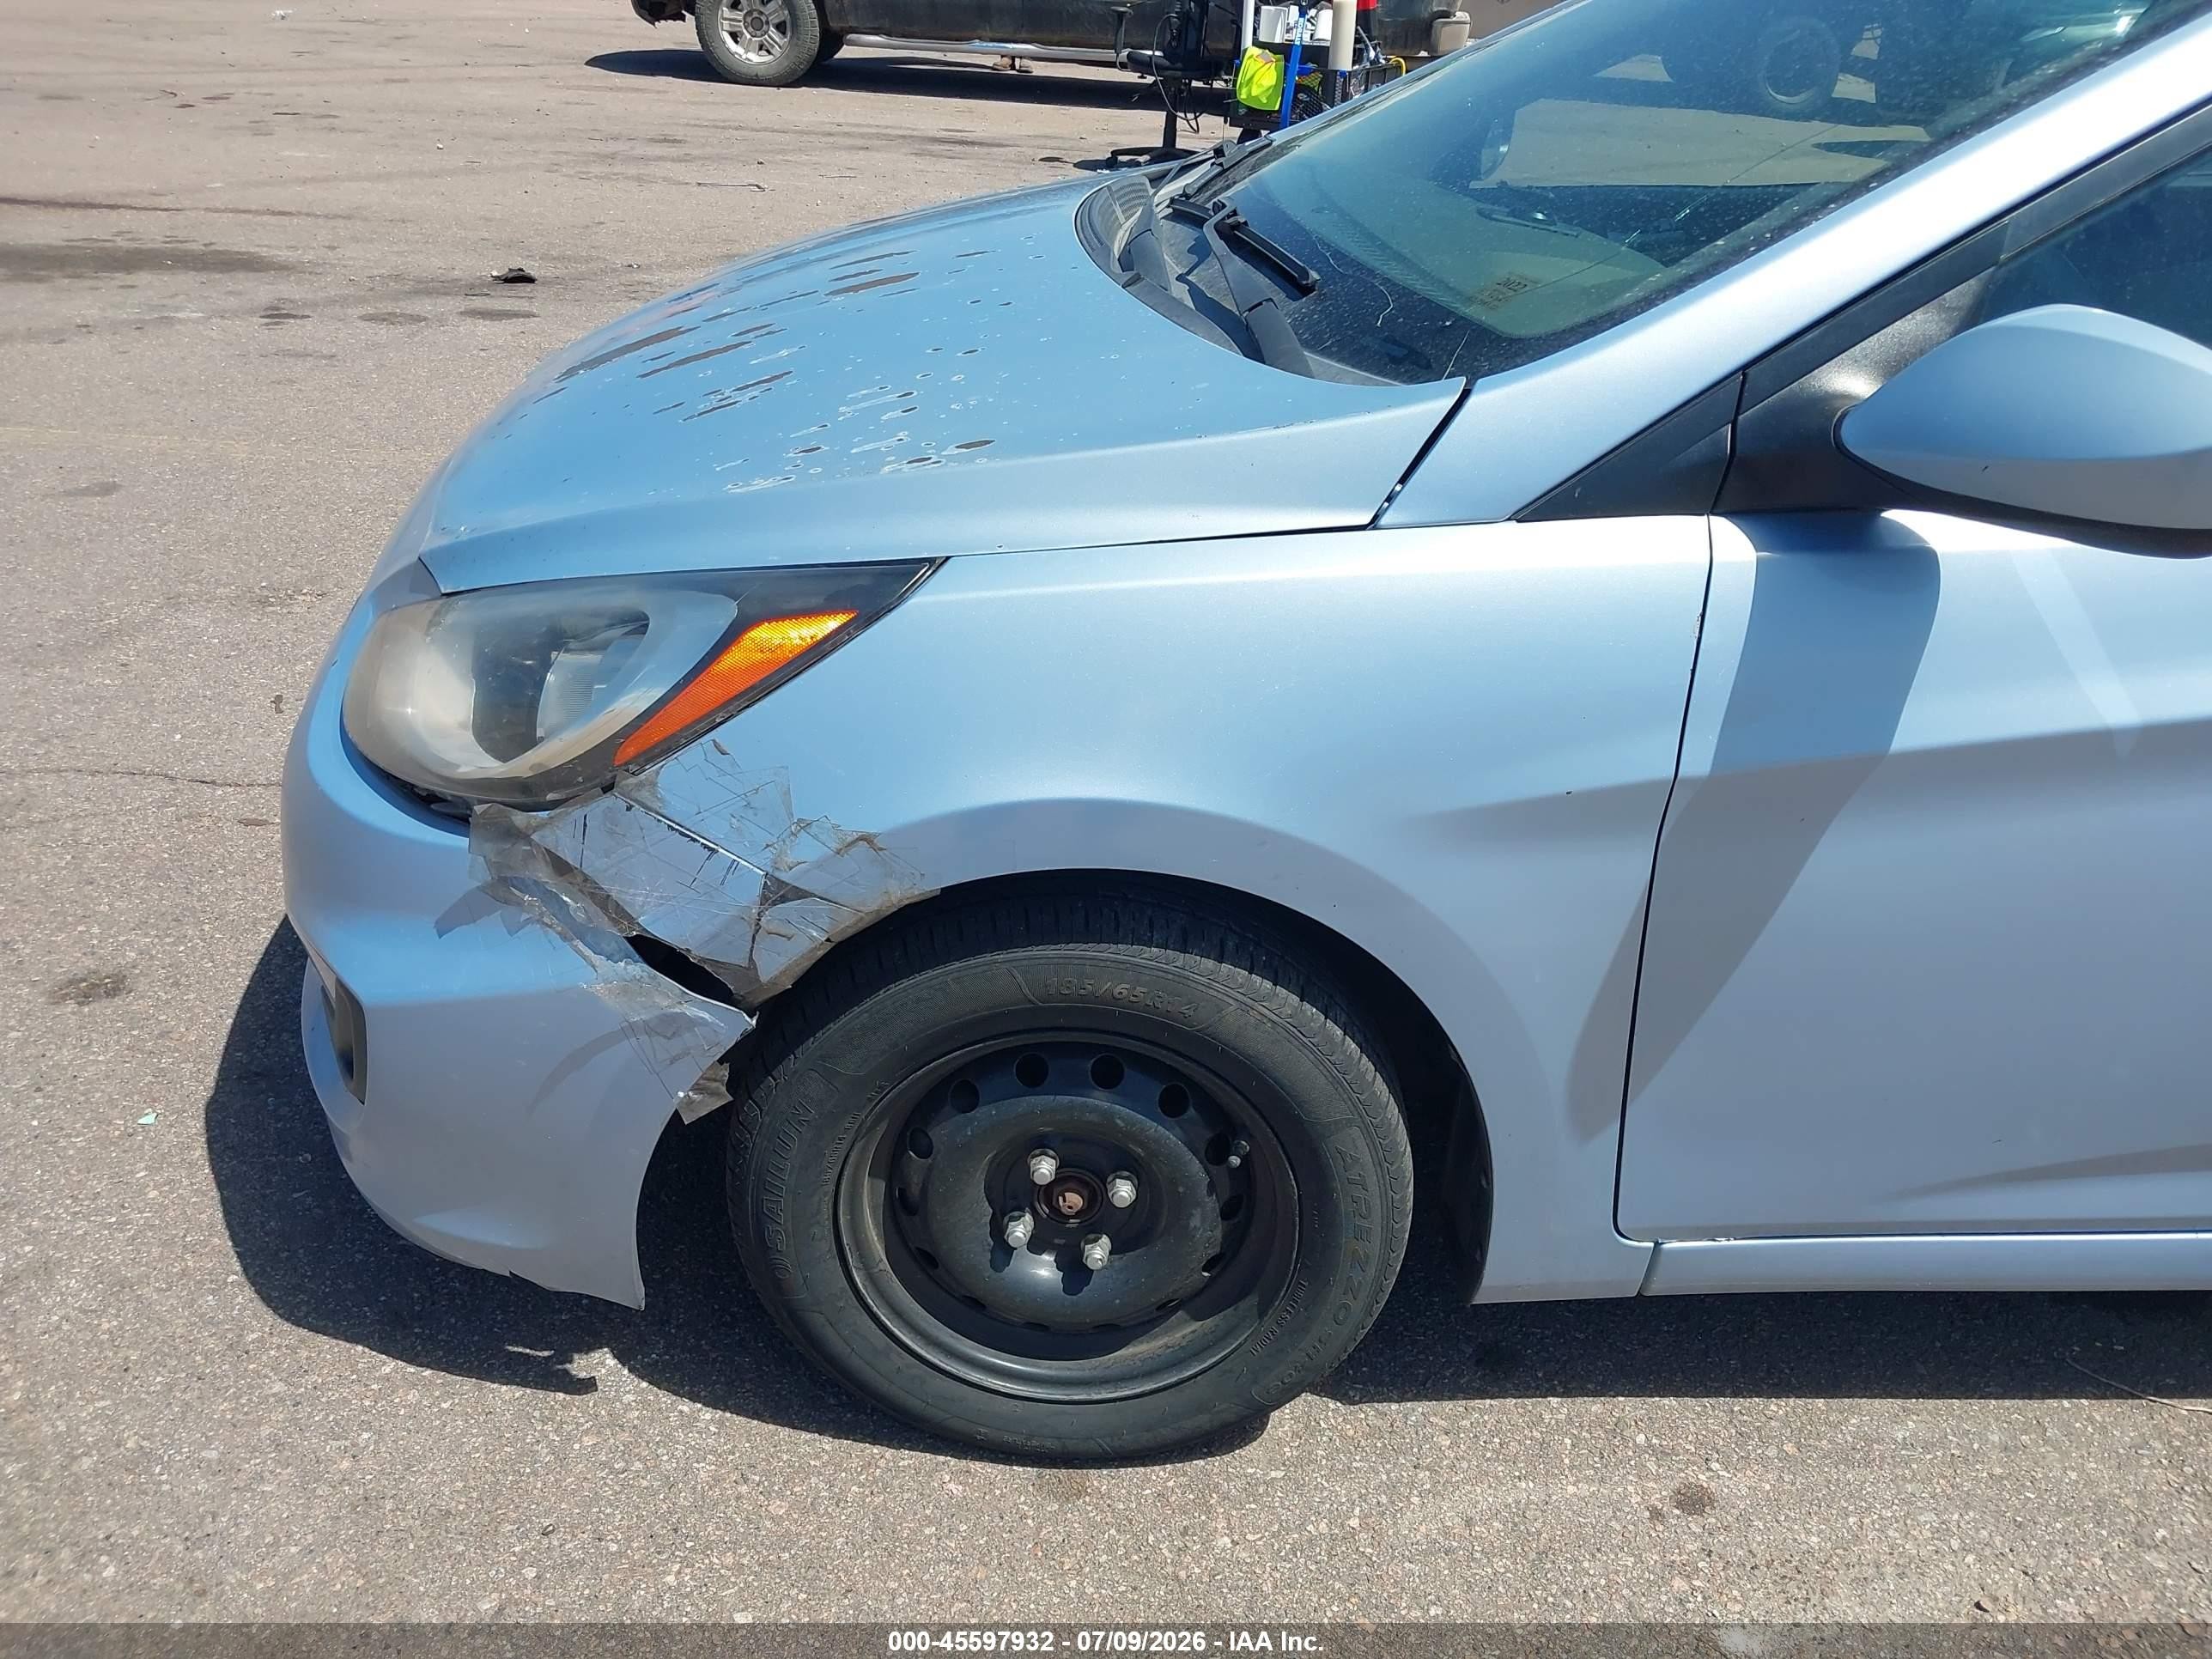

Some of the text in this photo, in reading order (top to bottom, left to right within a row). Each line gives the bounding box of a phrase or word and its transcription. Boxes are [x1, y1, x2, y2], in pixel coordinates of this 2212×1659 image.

[1046, 976, 1200, 1018] 185/65R14
[763, 1098, 815, 1251] SAILUN
[1333, 1145, 1374, 1326] ATREZZO
